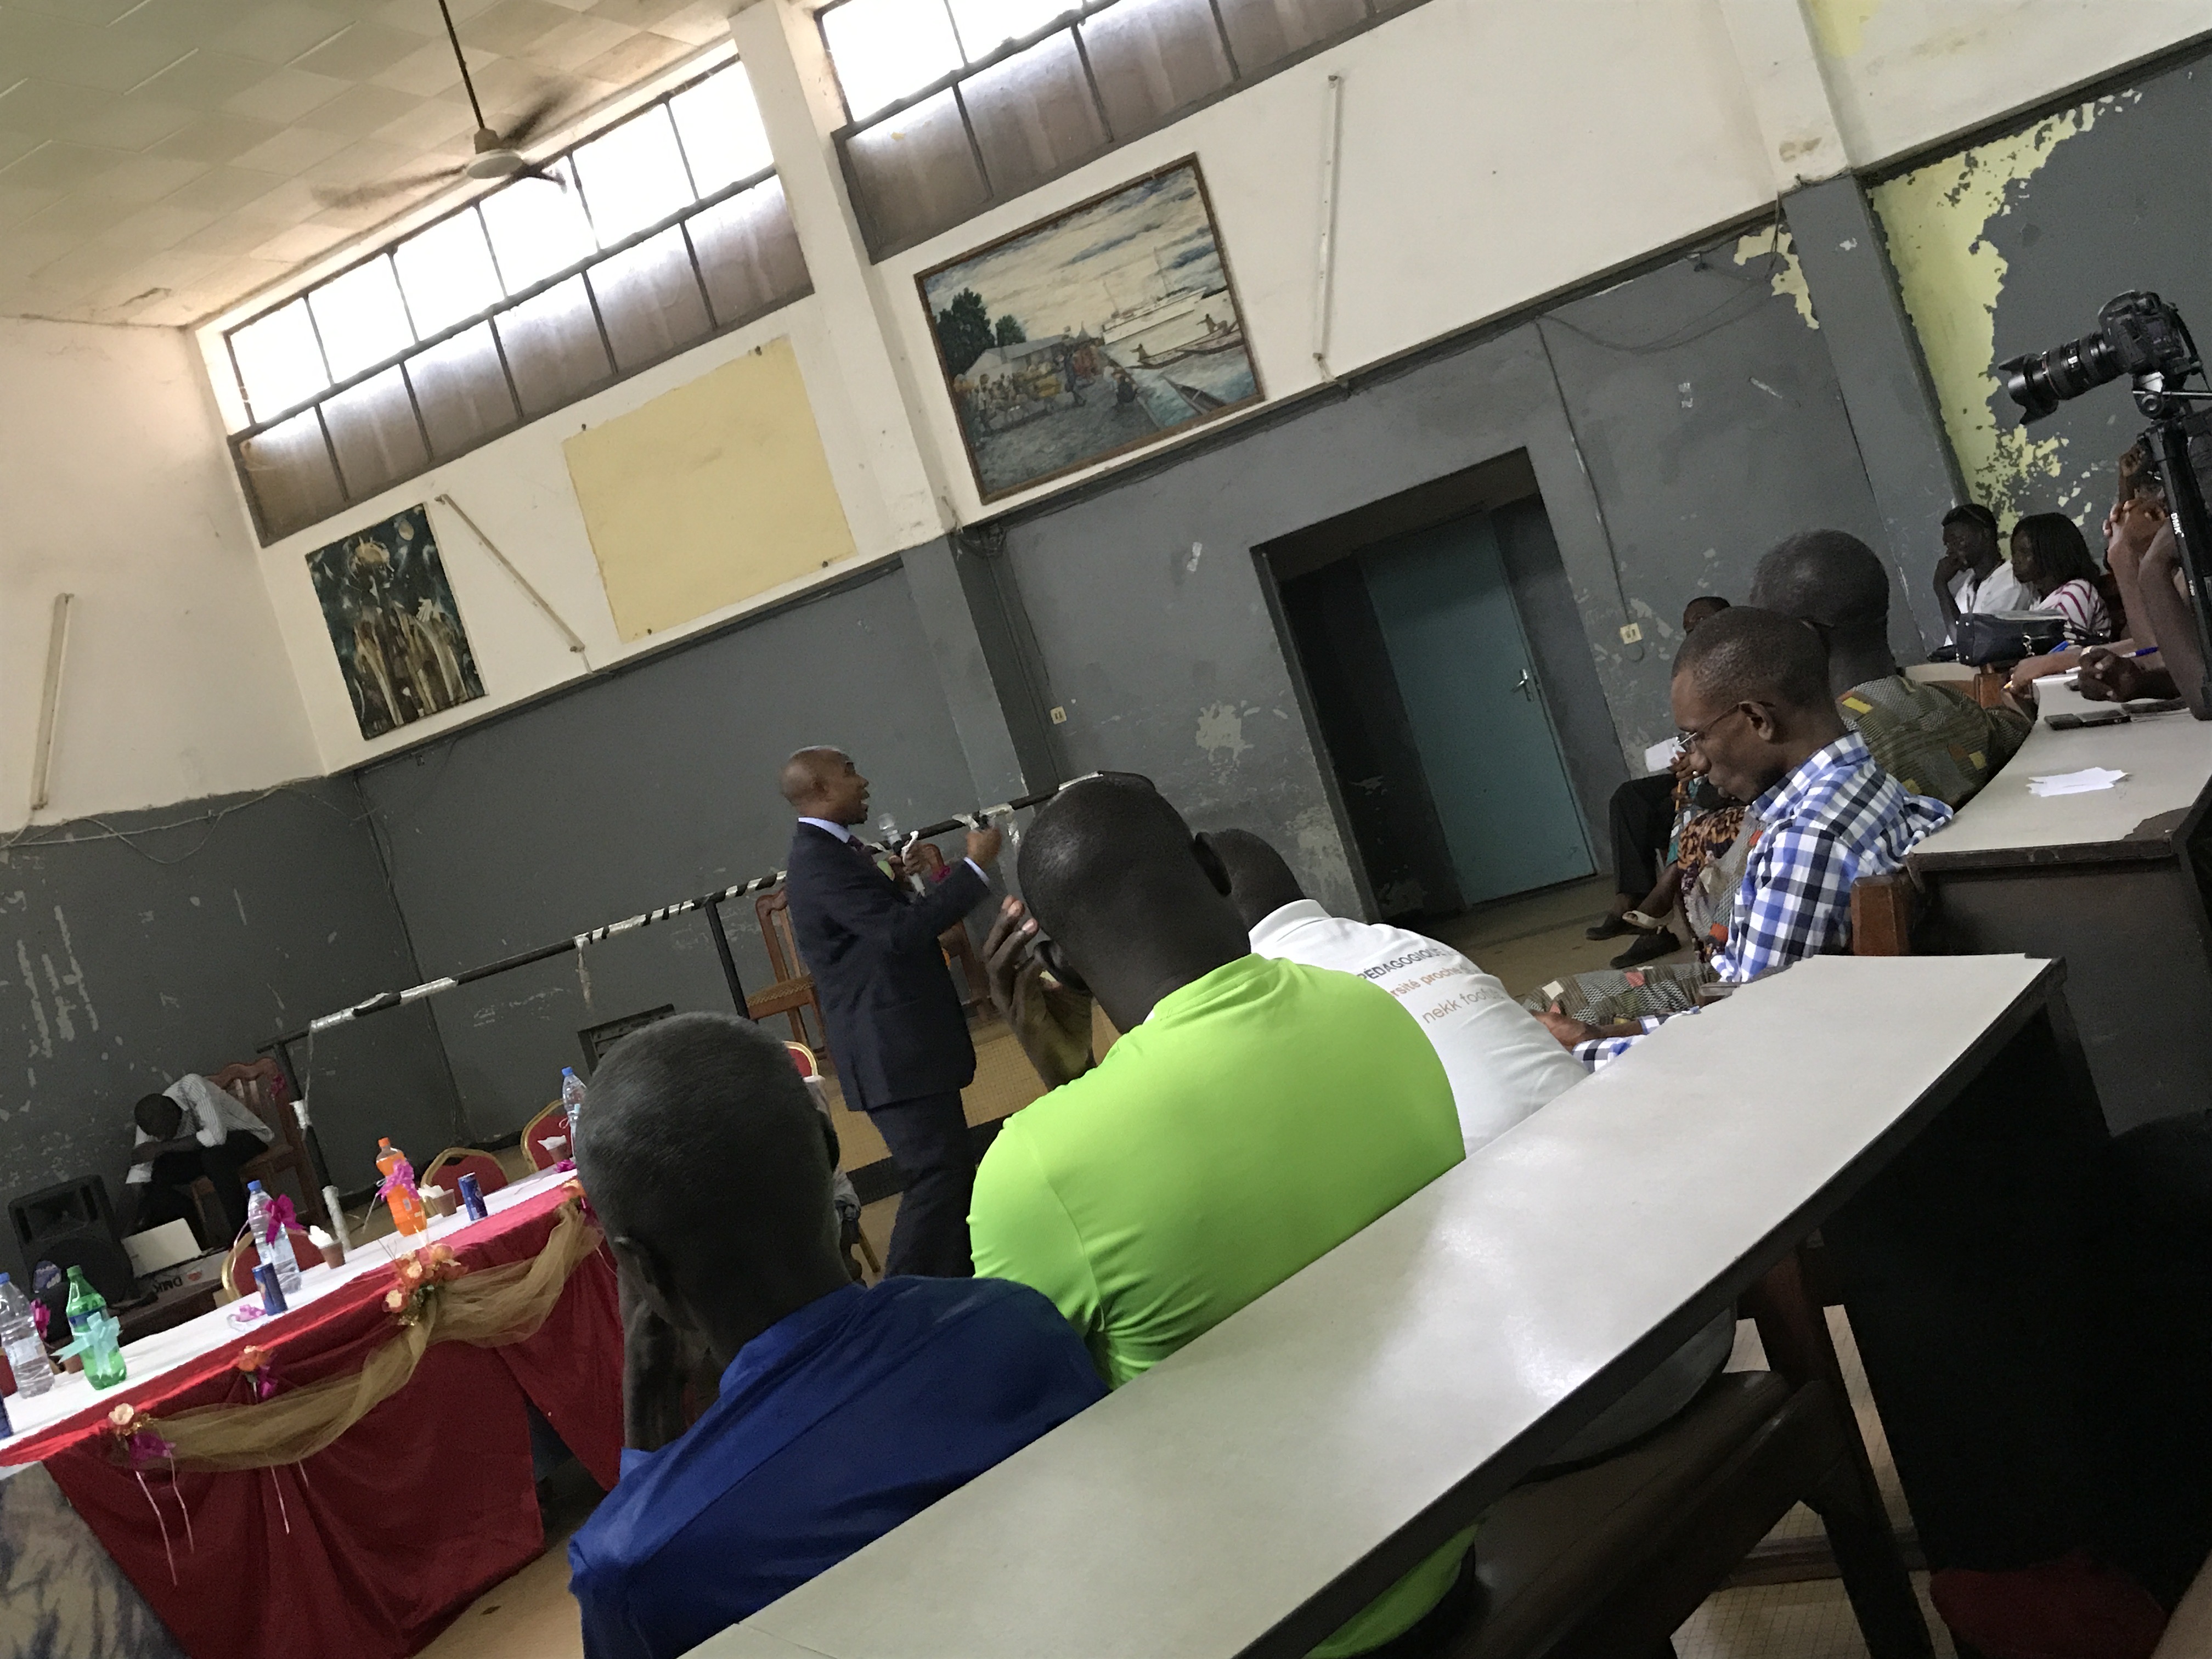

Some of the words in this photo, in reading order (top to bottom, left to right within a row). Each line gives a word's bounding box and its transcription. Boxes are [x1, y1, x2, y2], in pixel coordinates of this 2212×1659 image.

[2170, 512, 2182, 535] DMK
[1390, 980, 1421, 997] rsité
[1420, 967, 1463, 985] proche
[1421, 999, 1462, 1024] nekk
